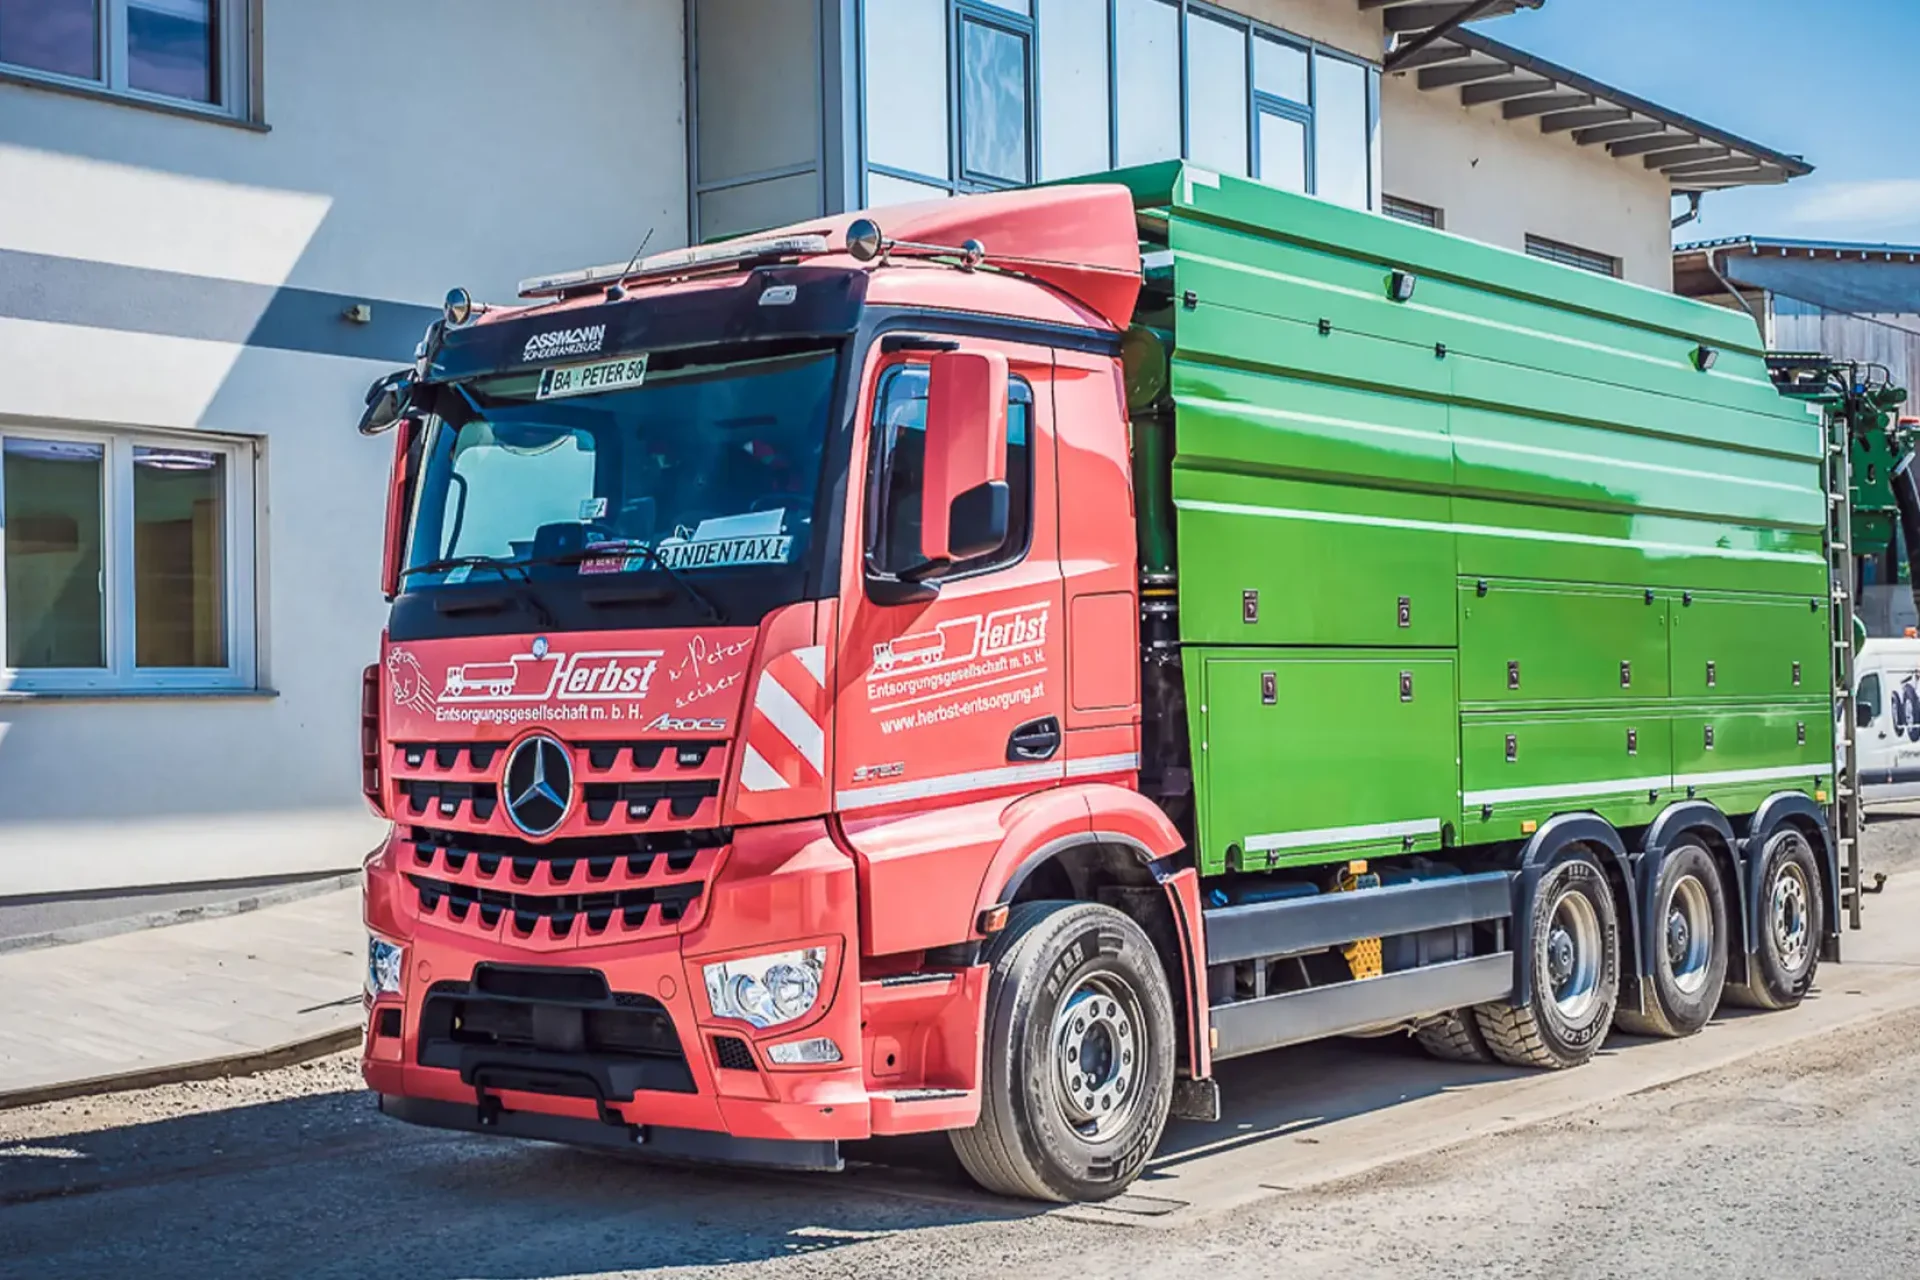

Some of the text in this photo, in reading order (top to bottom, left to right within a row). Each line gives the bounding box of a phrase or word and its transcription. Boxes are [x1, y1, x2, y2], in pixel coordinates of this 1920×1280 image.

[524, 324, 606, 350] ASSMANN
[554, 371, 572, 391] BA
[580, 363, 625, 387] PETER
[972, 609, 1048, 657] Herbst
[547, 652, 658, 700] Herbst
[867, 657, 1008, 700] Entsorgungsgesellschaft
[435, 703, 588, 724] Entsorgungsgesellschaft
[880, 681, 1045, 734] www.herbst-entsorgung.at
